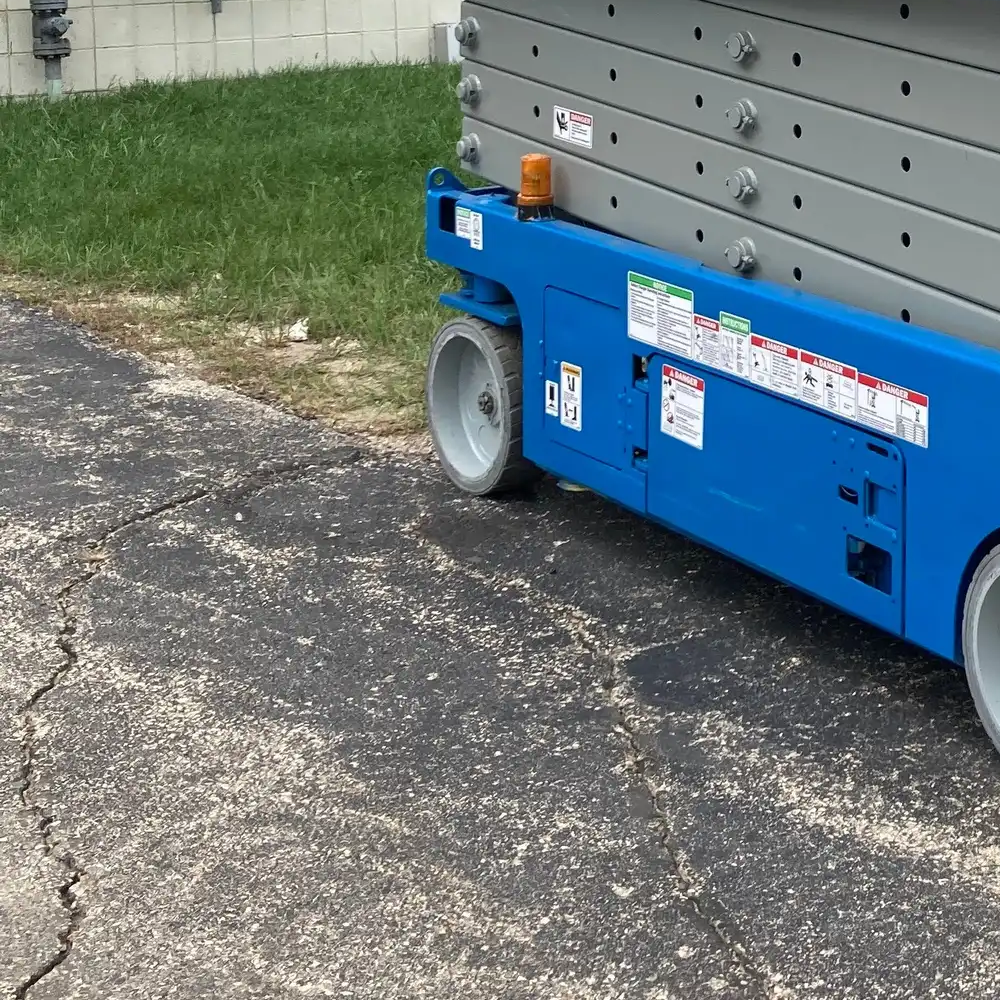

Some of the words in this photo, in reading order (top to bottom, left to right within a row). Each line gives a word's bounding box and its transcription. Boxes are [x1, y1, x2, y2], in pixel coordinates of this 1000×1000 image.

[700, 319, 717, 329] DANGER
[766, 341, 788, 355] DANGER
[819, 360, 844, 375] DANGER
[675, 371, 698, 387] DANGER
[882, 383, 909, 400] DANGER
